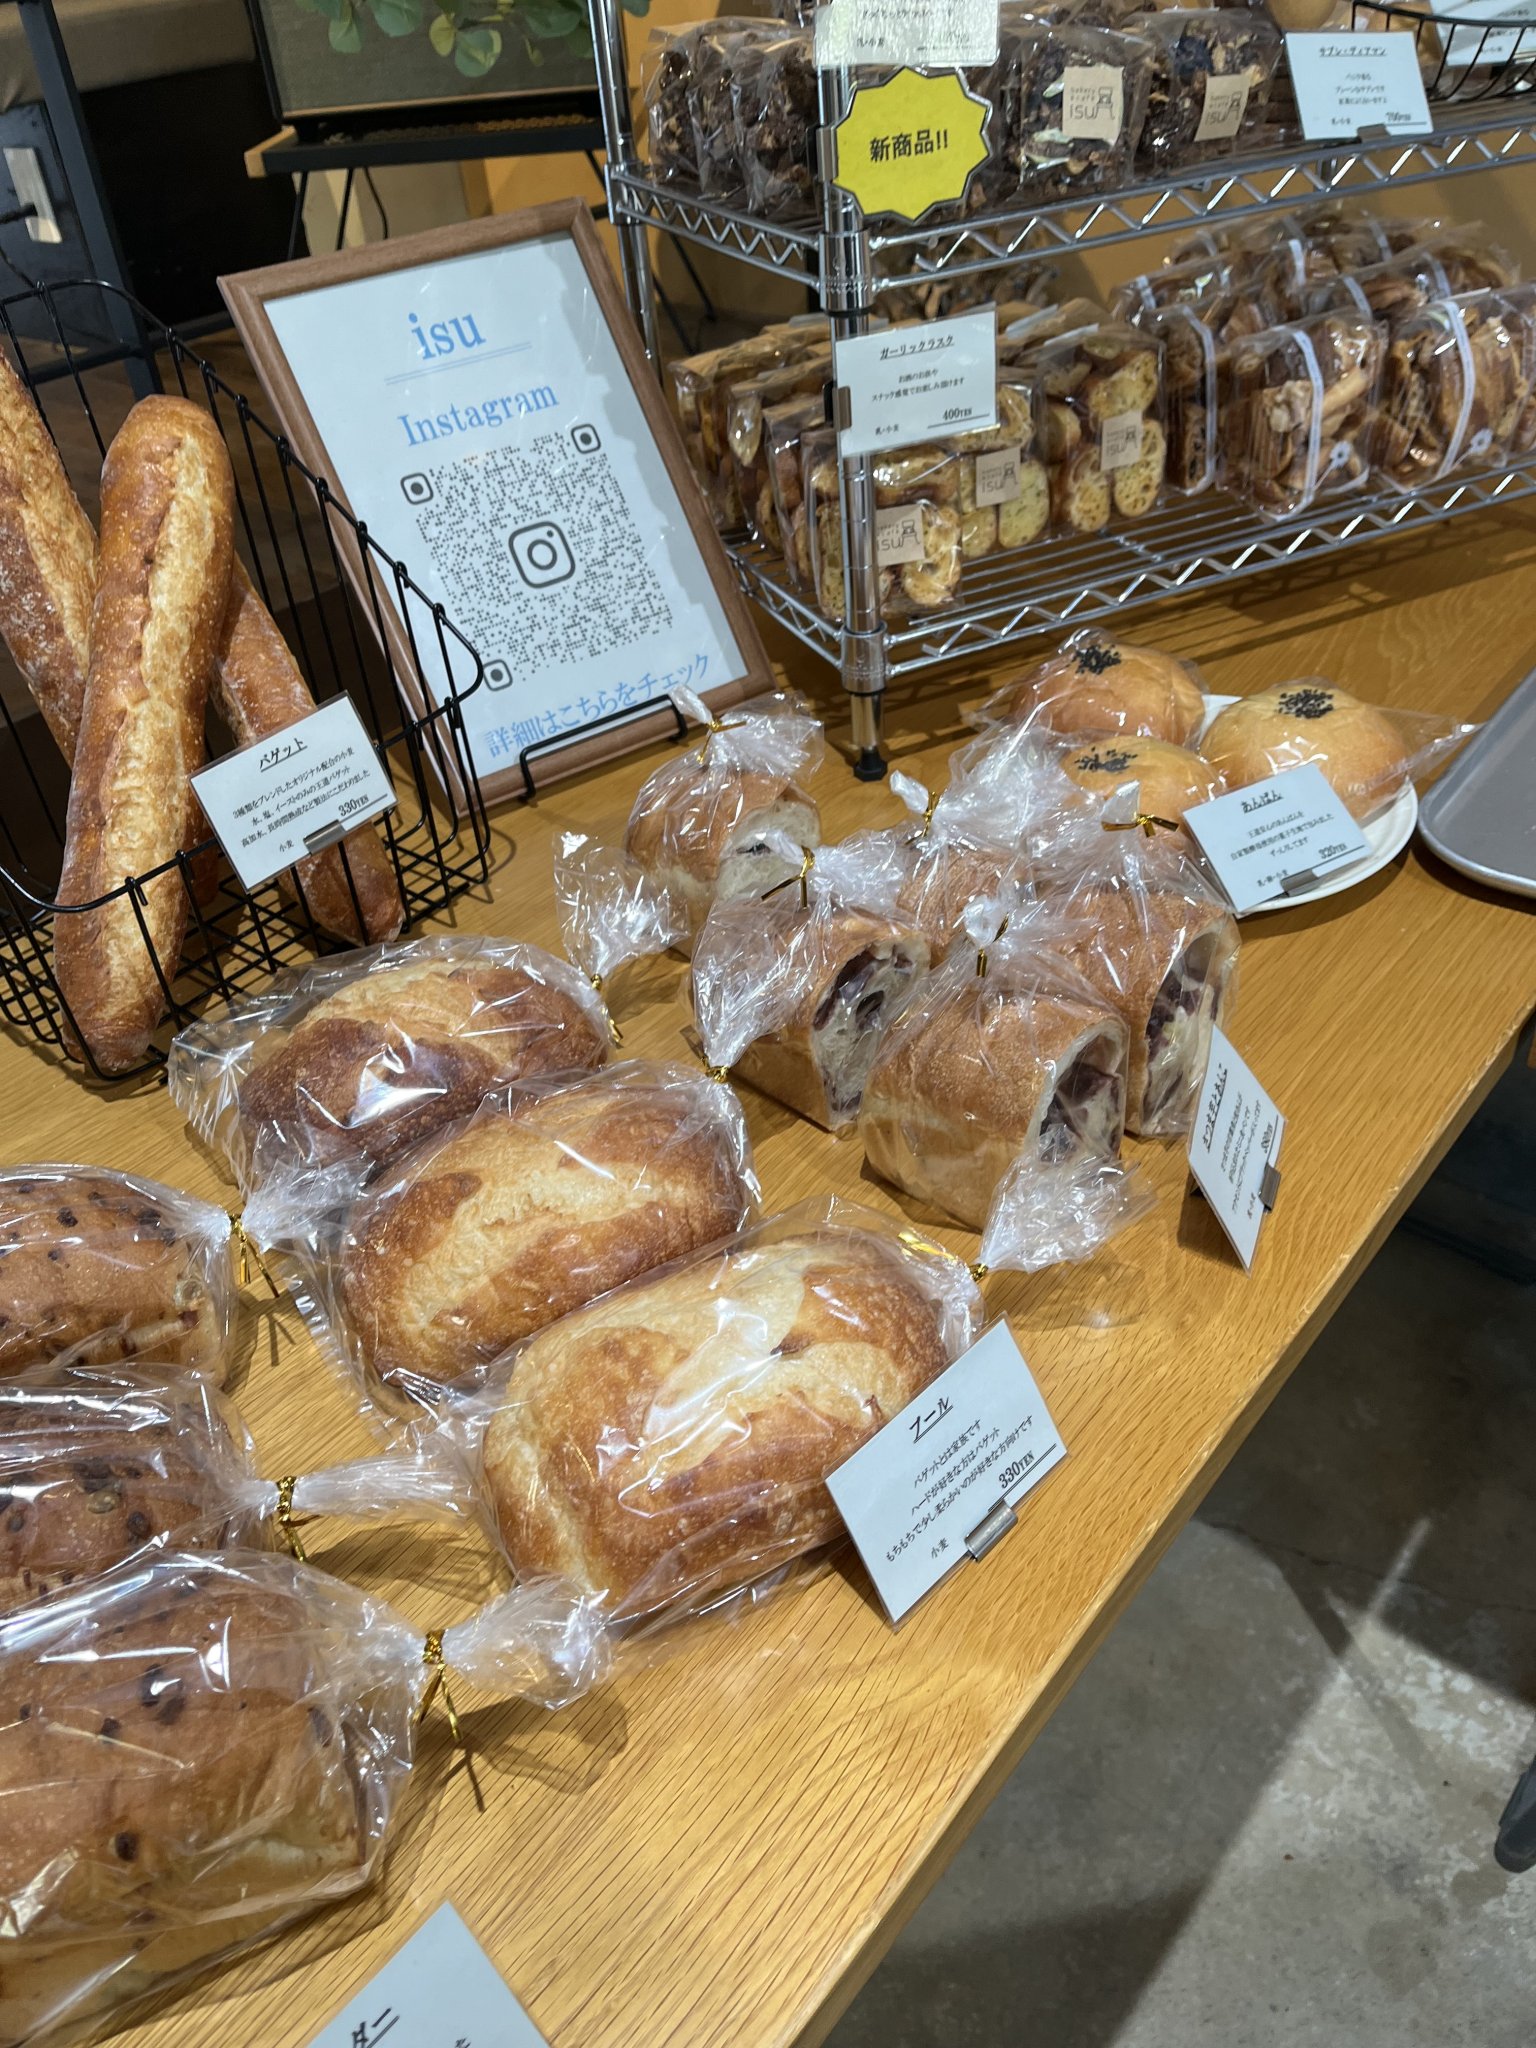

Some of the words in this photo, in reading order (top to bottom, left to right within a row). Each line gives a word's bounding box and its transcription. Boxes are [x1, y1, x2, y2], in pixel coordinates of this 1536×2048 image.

[869, 129, 948, 162] 新商品!!
[408, 312, 487, 360] isu
[880, 335, 954, 360] ガーリックラスク
[398, 384, 560, 447] Instagram
[942, 407, 973, 421] 400YEN
[483, 653, 709, 758] 詳細はこちらをチェック
[259, 737, 306, 770] バゲット
[233, 747, 355, 819] 3種類をブレンドしたオリジナル配合の小麦
[252, 766, 350, 826] 水、塩、イーストのみの王道バゲット
[1241, 790, 1284, 813] あんぱん
[338, 794, 370, 817] 330YEN
[279, 840, 294, 852] 小麦
[909, 1396, 951, 1443] ブール
[911, 1427, 1001, 1516] ハードが好きな方はバゲット
[913, 1419, 982, 1488] バゲットとは家族です
[998, 1450, 1036, 1489] 330YEN
[886, 1415, 1034, 1563] もちもちで少し柔らかいのが好きな方向けです
[930, 1537, 949, 1559] 小麦
